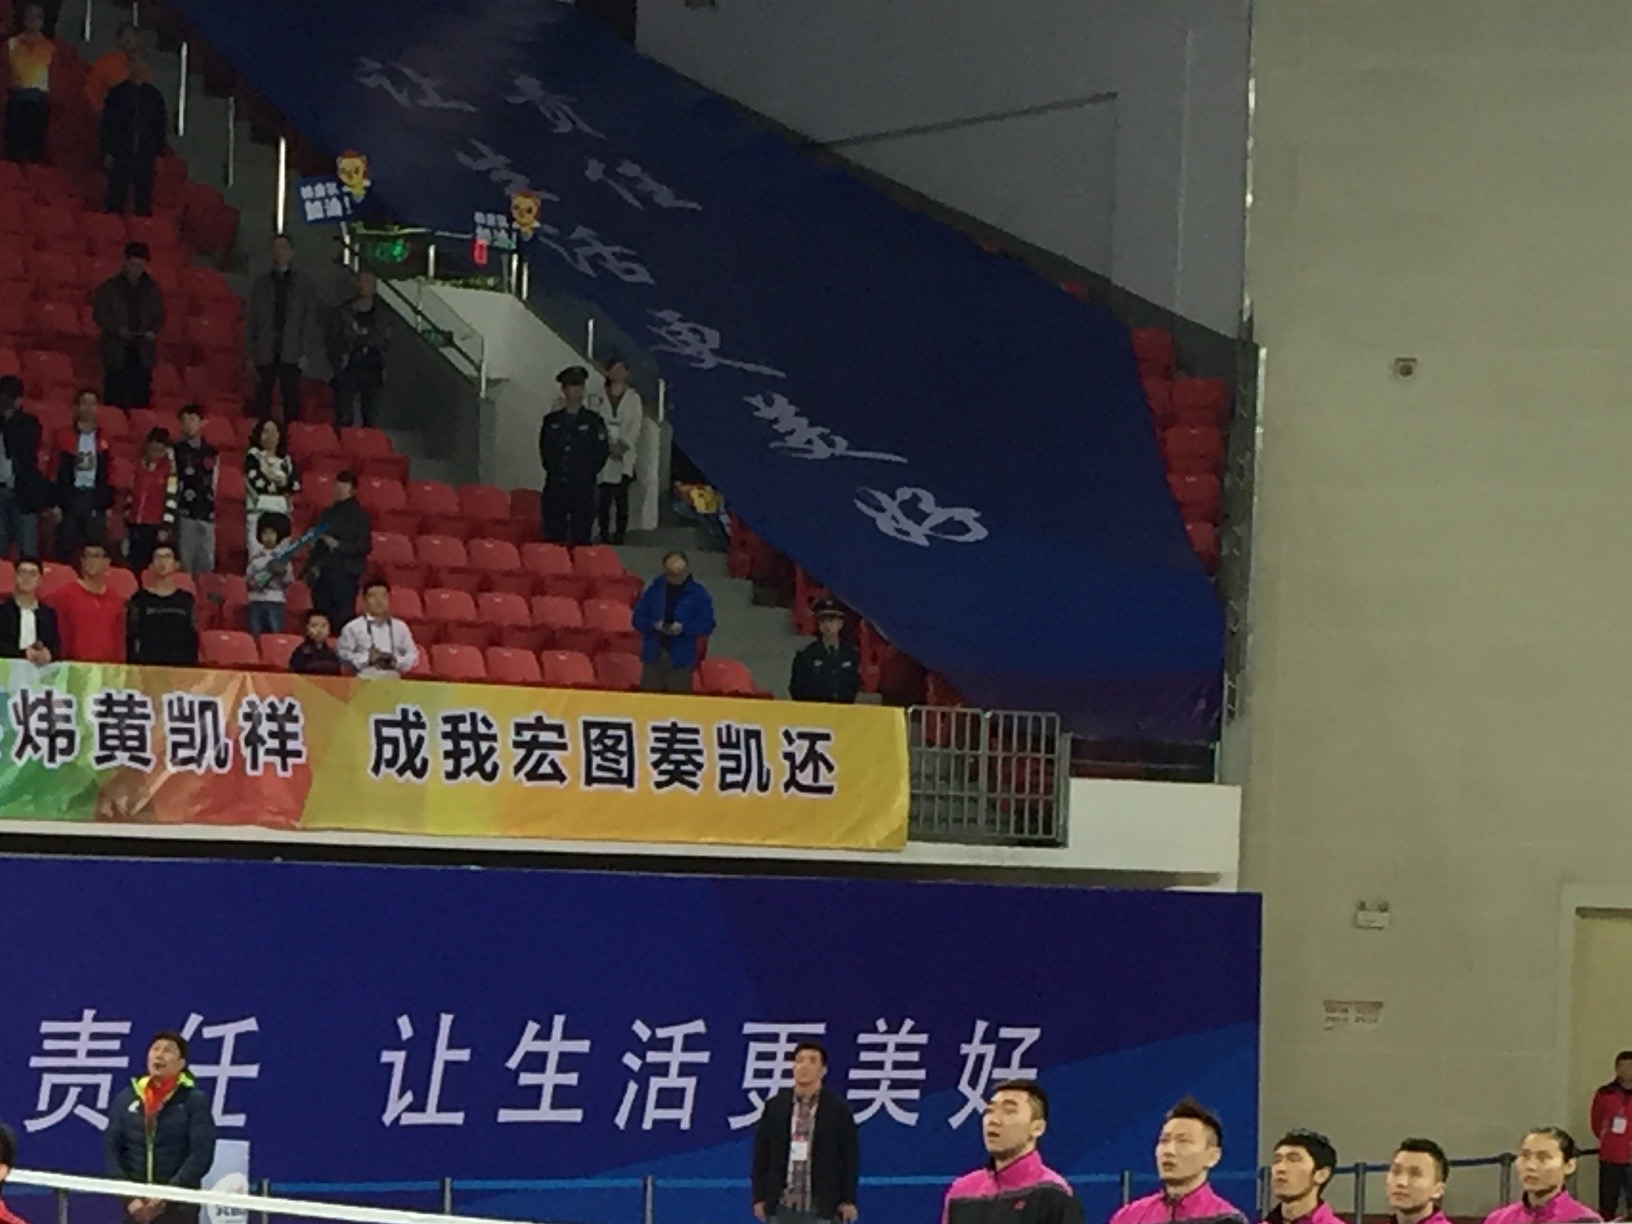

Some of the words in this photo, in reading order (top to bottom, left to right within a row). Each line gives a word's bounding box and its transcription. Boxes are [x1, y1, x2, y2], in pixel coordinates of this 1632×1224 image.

[370, 706, 838, 796] 成我宏图奏凯还
